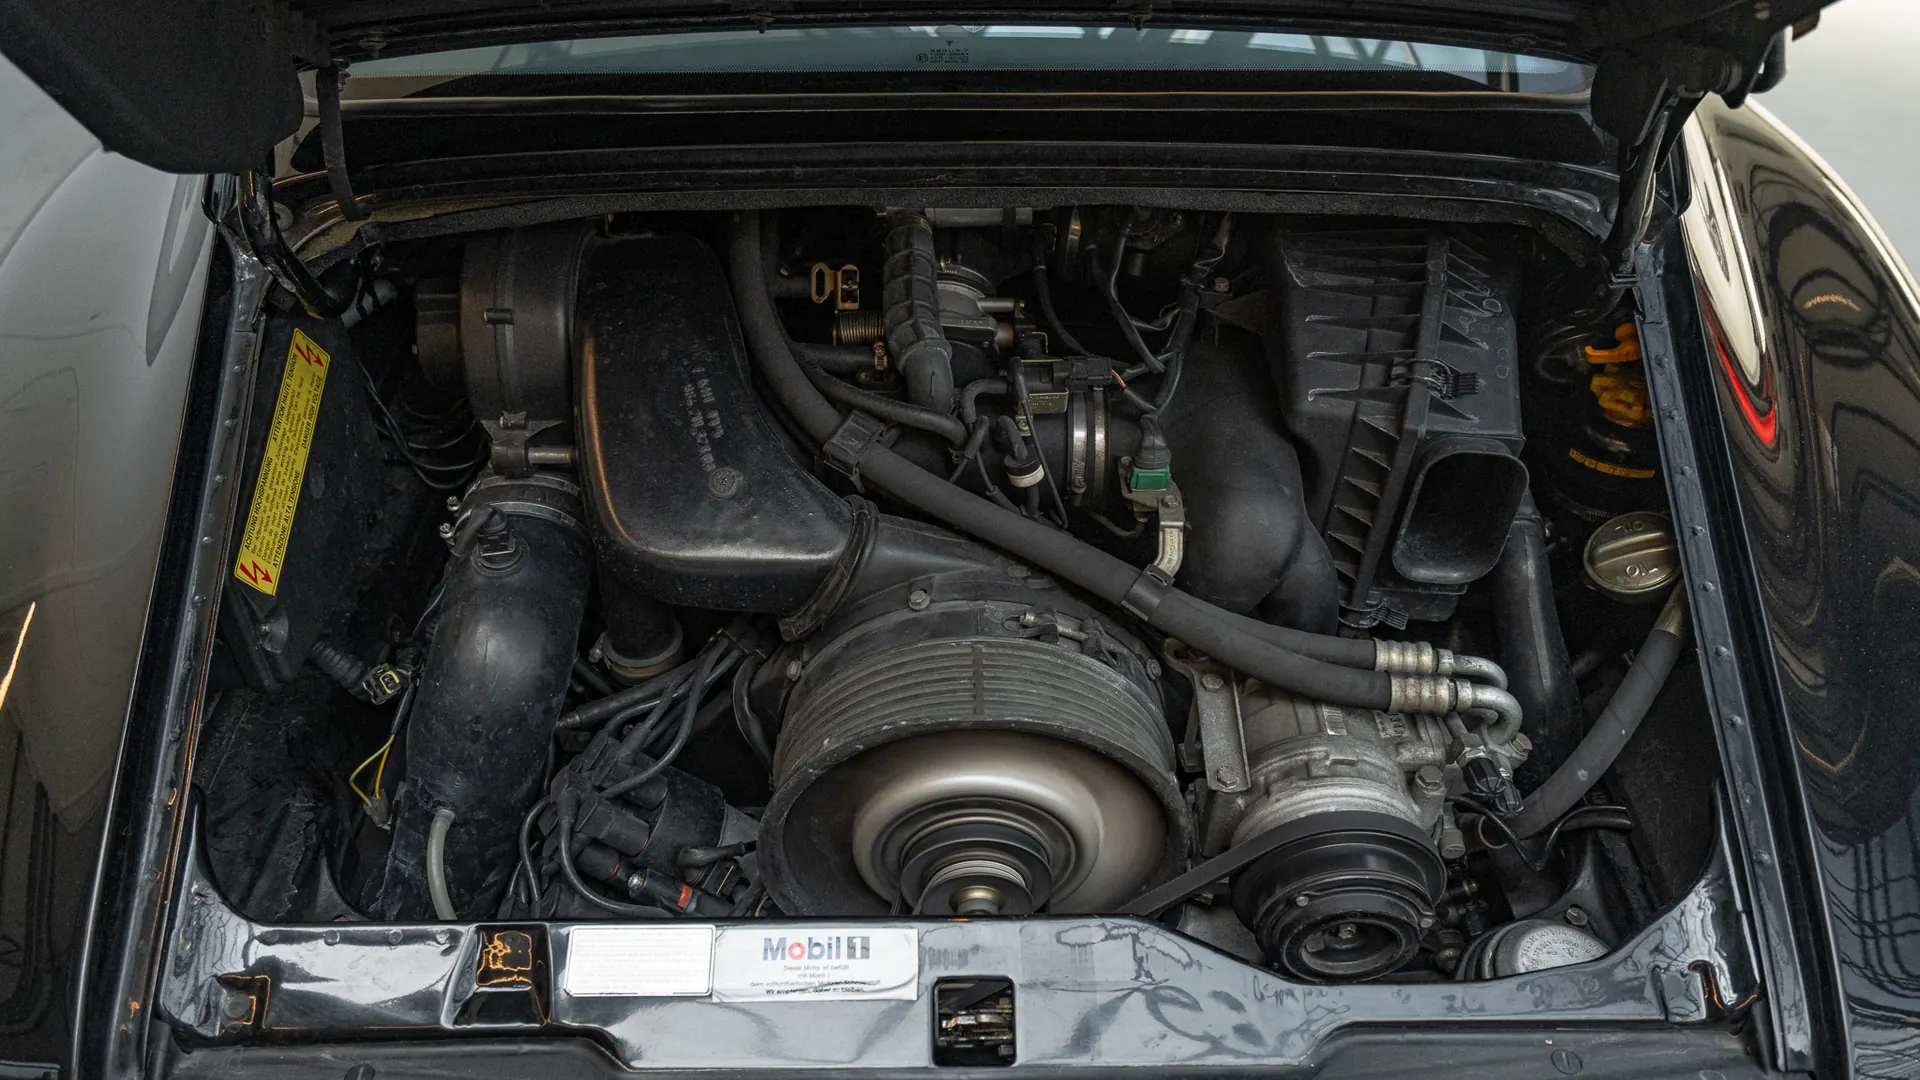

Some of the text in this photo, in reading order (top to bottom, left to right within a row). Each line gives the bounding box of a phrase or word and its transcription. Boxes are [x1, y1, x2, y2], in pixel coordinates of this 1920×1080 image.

[272, 353, 297, 443] ATTENTION HAUTE TENSION
[301, 374, 322, 449] DANGER HIGH VOLTAGE
[244, 455, 272, 550] ACHTUNG HOCHSPANNUNG
[272, 469, 300, 568] ATTENZIONE ALTA TENSIONE
[1615, 521, 1644, 533] OIL
[1626, 562, 1659, 577] OIL
[763, 936, 841, 961] Mobil
